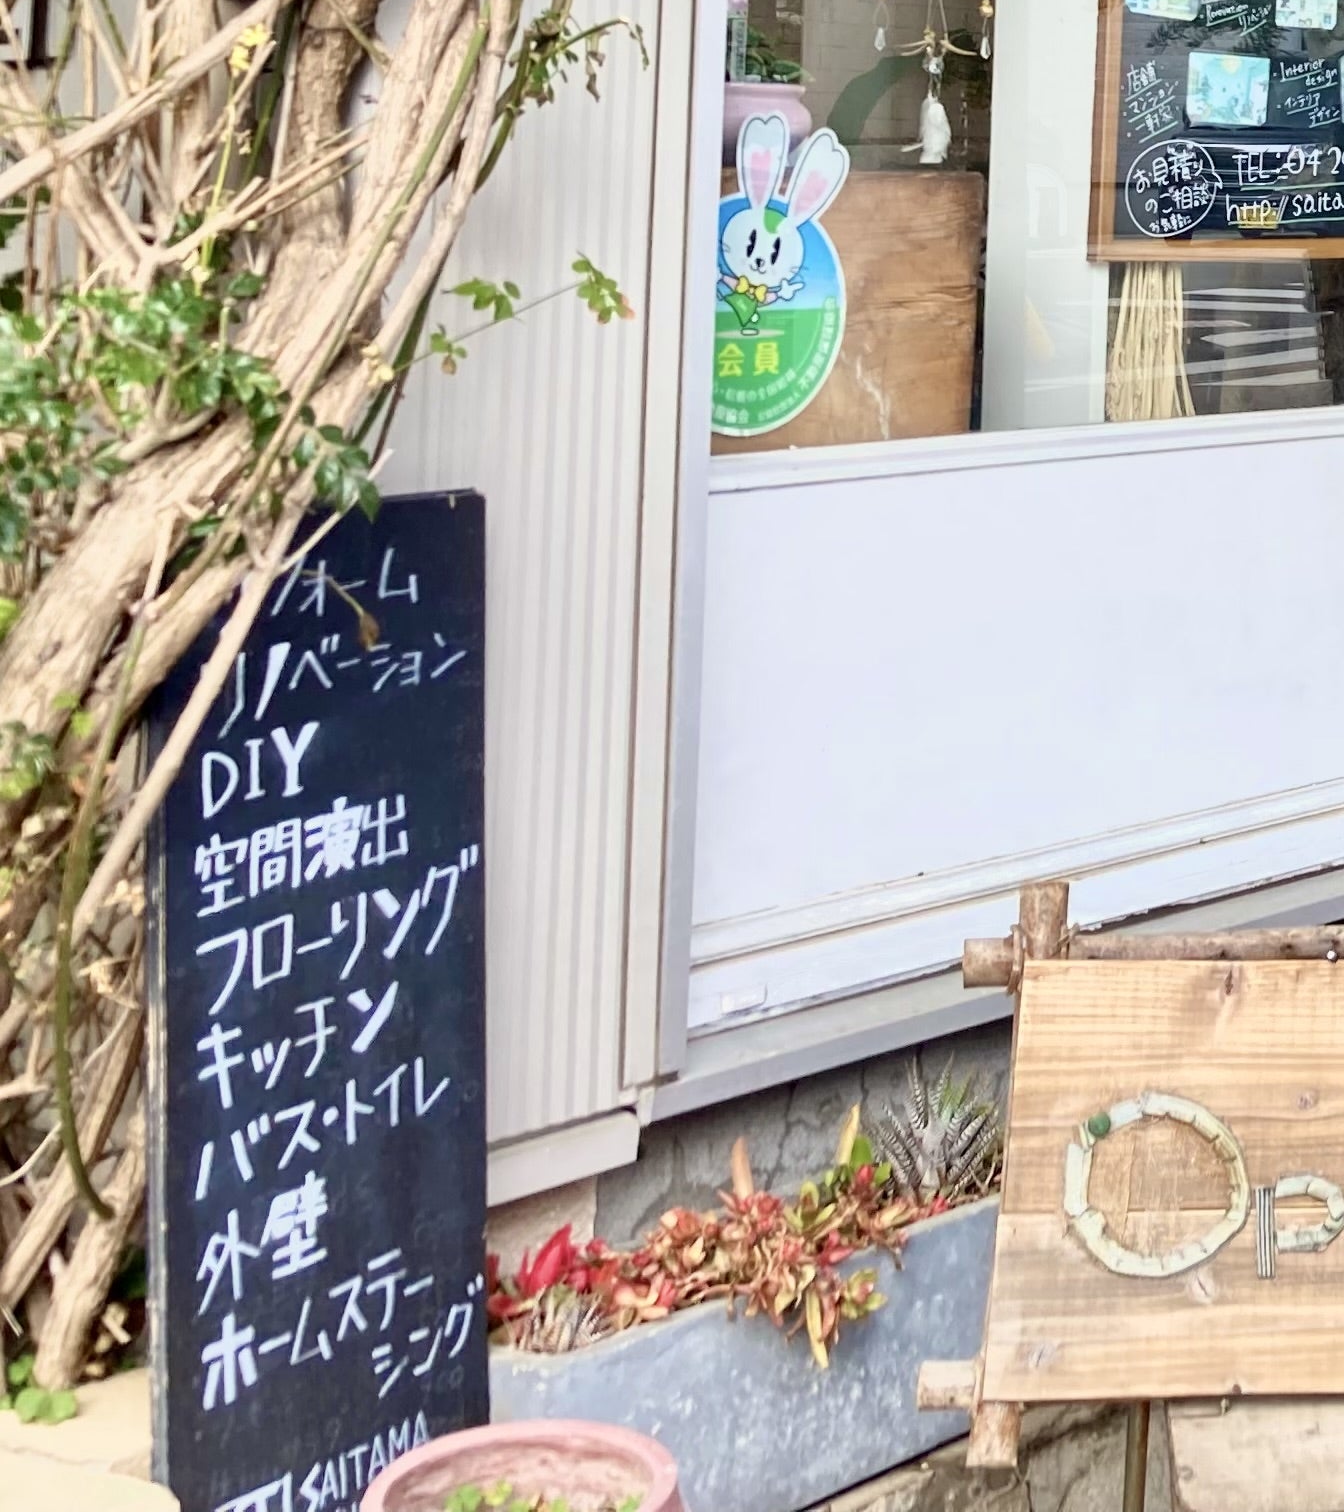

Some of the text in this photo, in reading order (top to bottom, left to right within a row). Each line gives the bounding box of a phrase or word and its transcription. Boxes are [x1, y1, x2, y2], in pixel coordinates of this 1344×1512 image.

[201, 721, 321, 820] DIY
[194, 794, 409, 918] 空間演出
[196, 844, 481, 1016] フローリング
[196, 981, 400, 1110] キッチン
[196, 1169, 330, 1318] 外壁
[299, 1408, 431, 1512] SAITAMA
